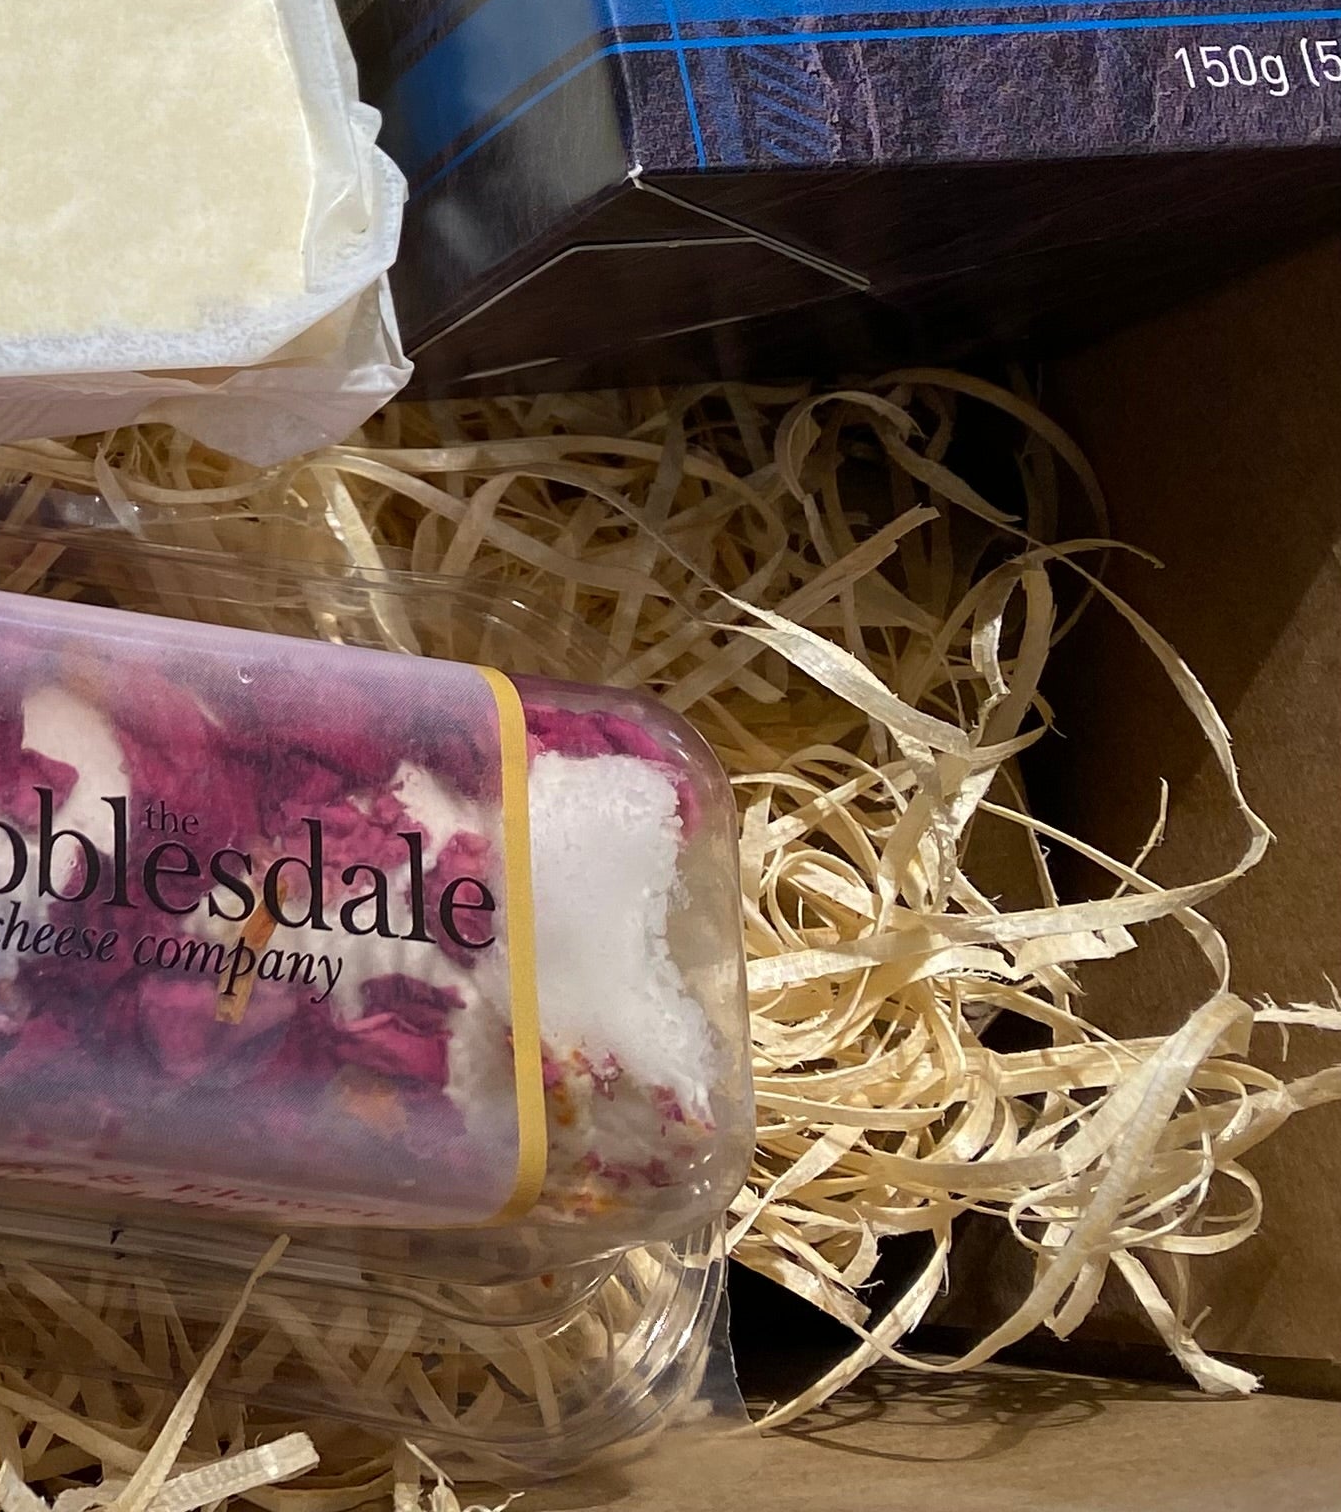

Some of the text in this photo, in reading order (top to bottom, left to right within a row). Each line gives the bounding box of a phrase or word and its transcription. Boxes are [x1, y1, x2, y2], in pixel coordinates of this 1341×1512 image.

[1173, 43, 1290, 97] 150g
[146, 800, 199, 836] the
[133, 930, 343, 1003] company
